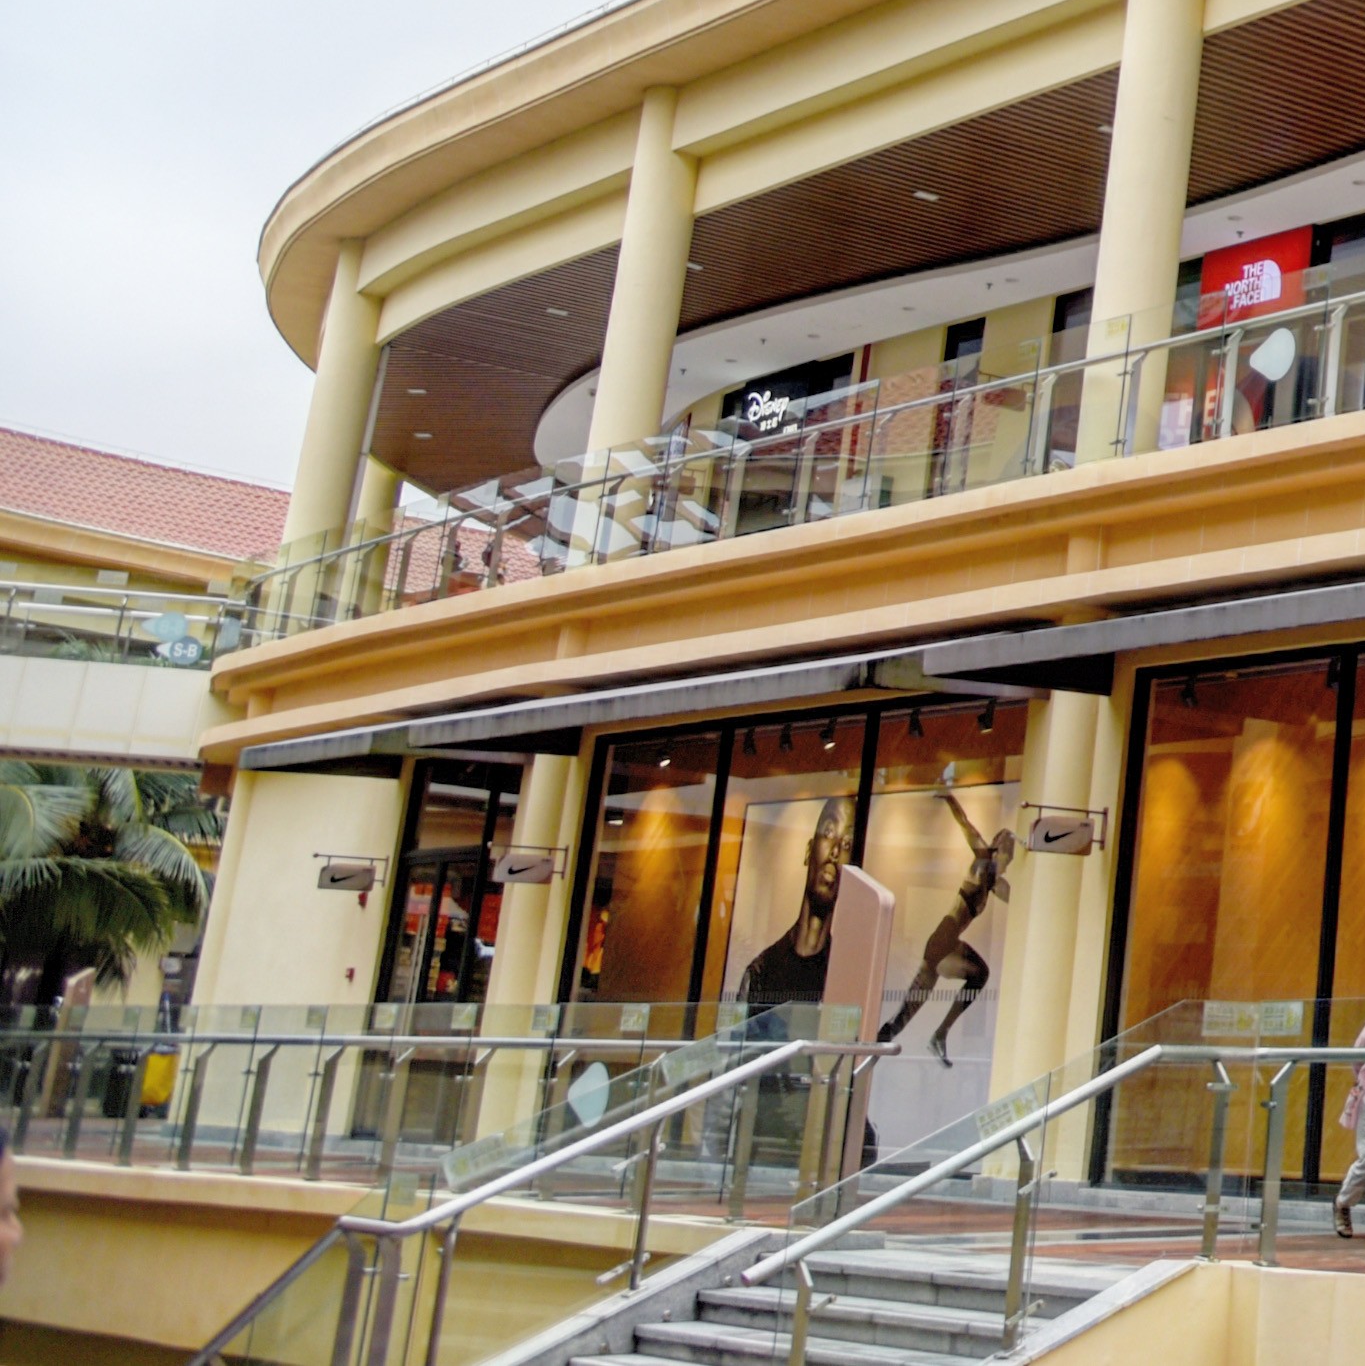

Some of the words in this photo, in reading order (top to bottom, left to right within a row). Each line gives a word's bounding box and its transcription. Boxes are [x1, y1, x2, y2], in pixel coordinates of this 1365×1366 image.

[1242, 260, 1264, 279] THE
[1225, 276, 1262, 297] NORTH
[1231, 290, 1262, 310] FACE
[173, 643, 198, 658] S-B
